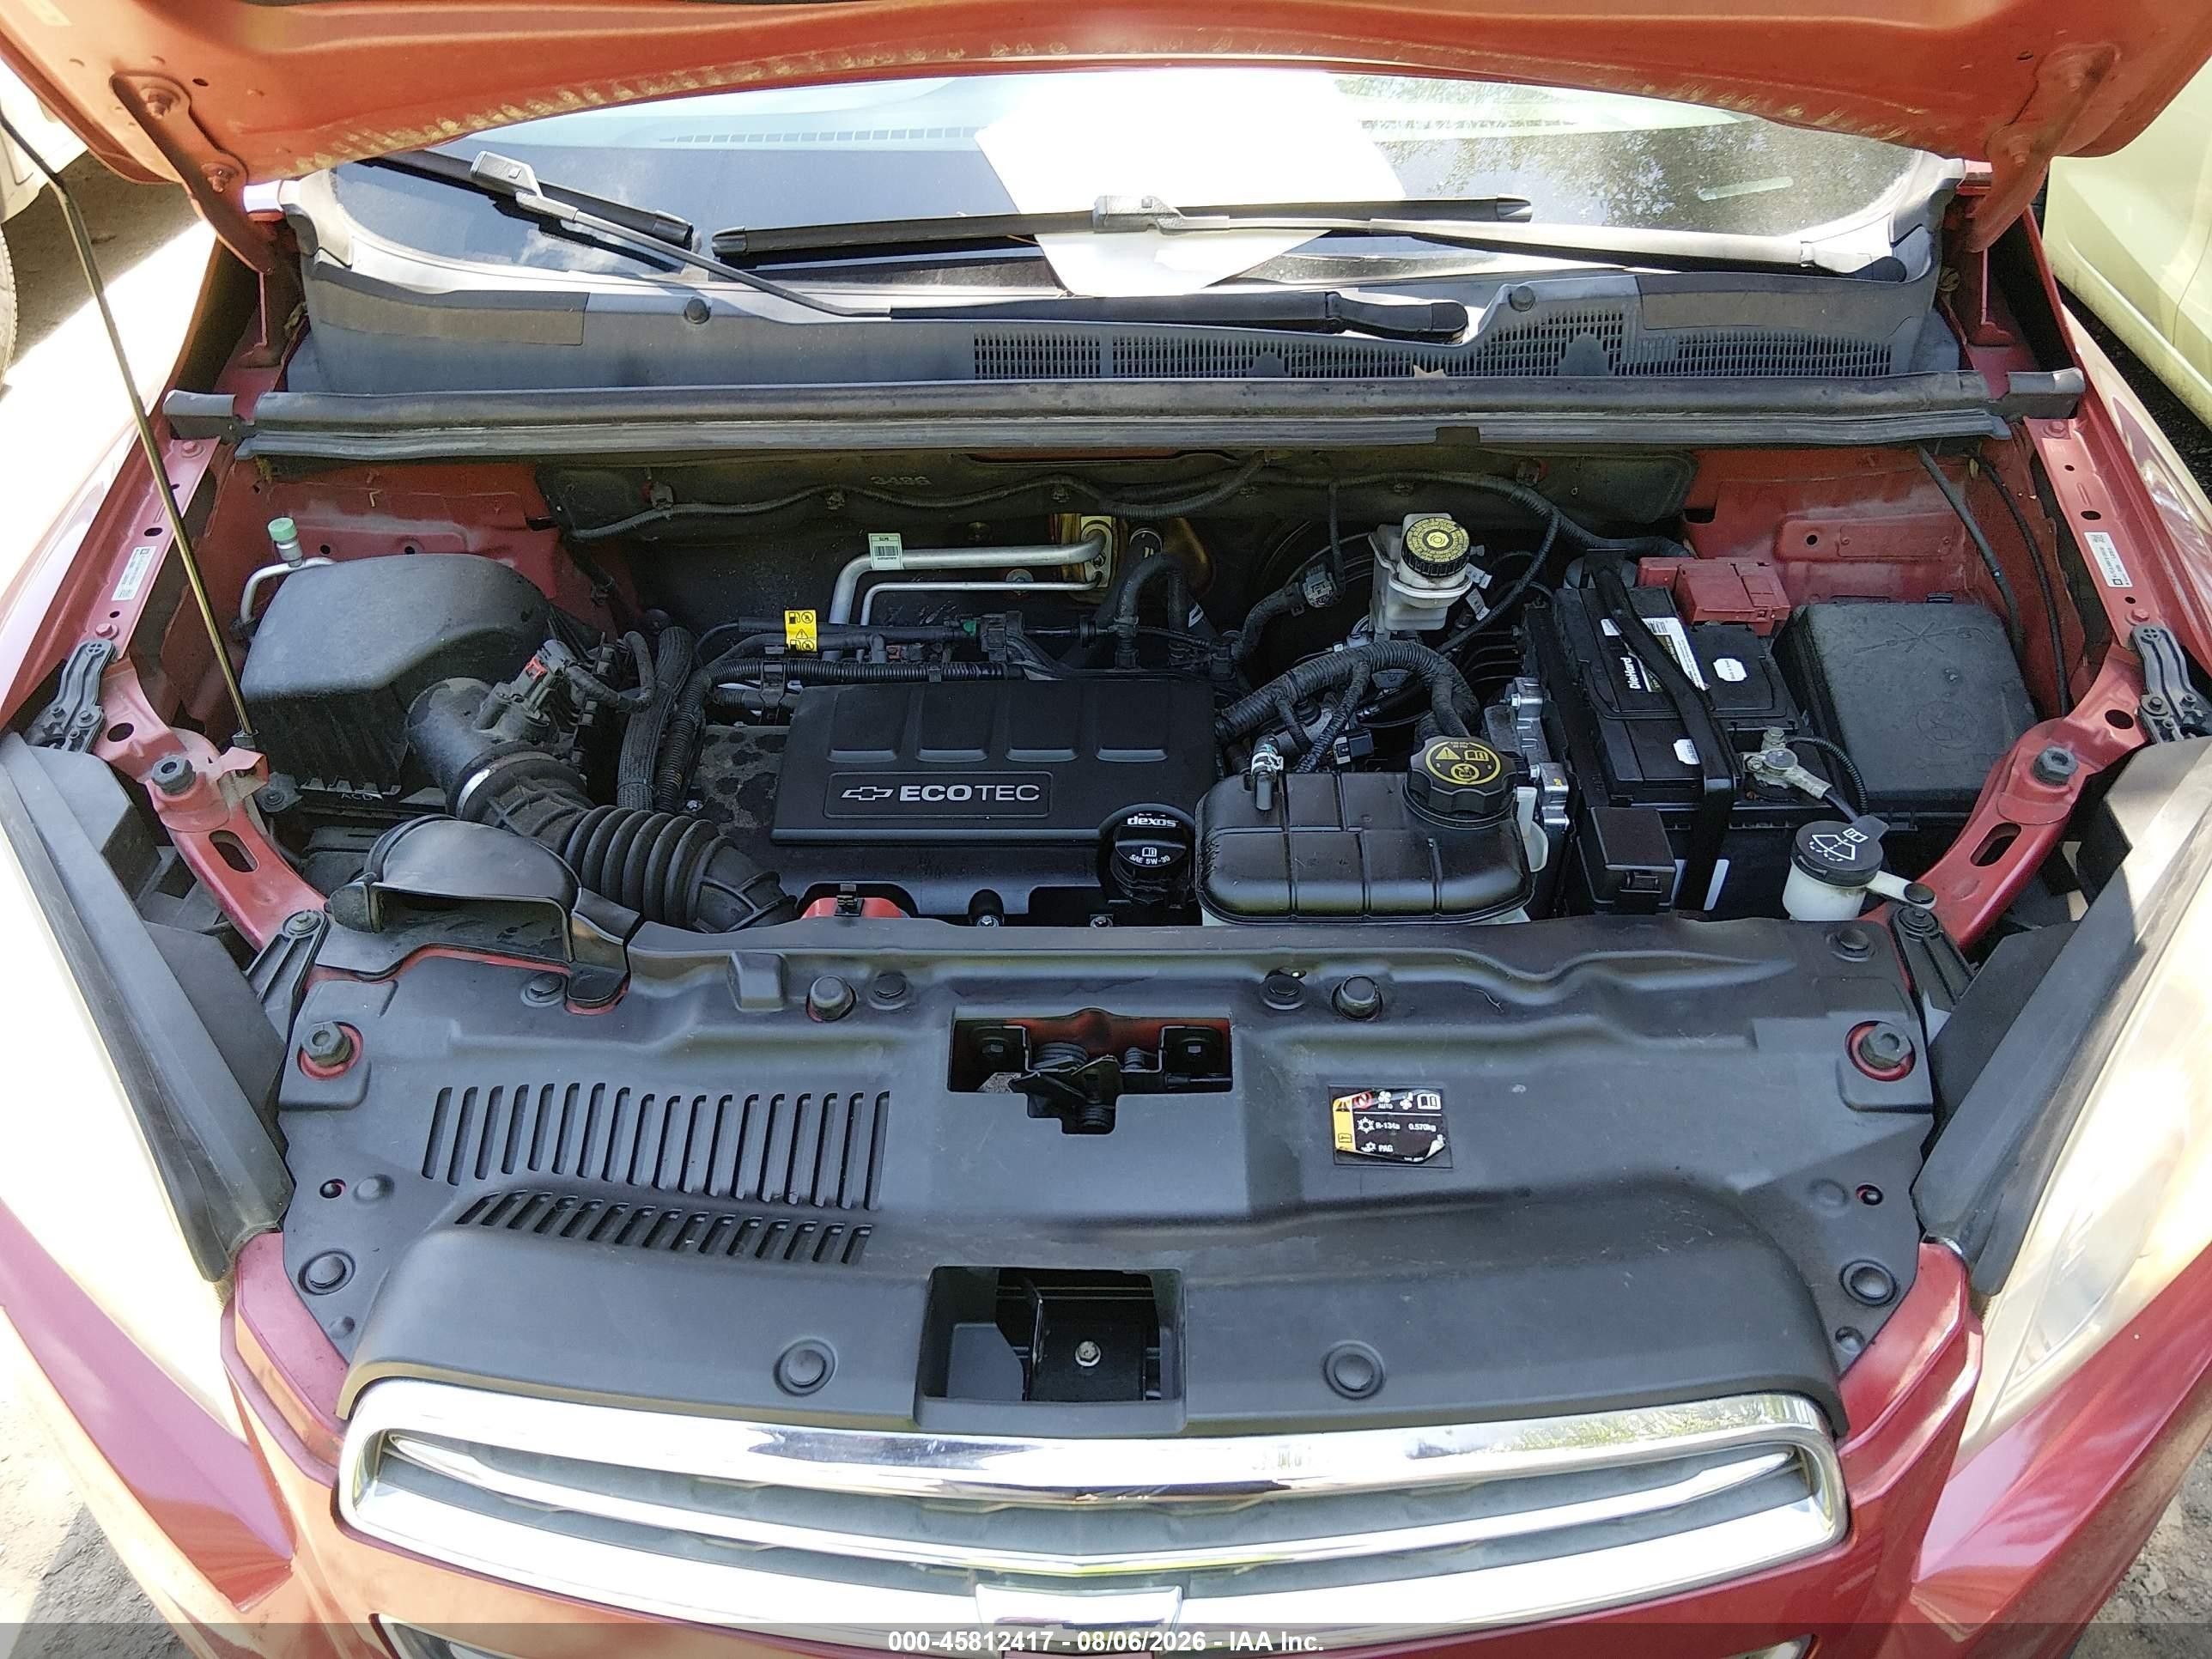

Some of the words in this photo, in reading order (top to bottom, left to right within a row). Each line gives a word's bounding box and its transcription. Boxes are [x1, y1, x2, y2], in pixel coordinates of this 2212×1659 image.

[1620, 657, 1643, 690] DieHard
[899, 784, 1041, 802] ECOTEC
[1127, 815, 1180, 828] dexos
[1128, 854, 1144, 864] SAE
[1145, 855, 1171, 865] 5W-30
[1408, 1122, 1437, 1132] 0.570kg
[1377, 1144, 1394, 1152] PAG
